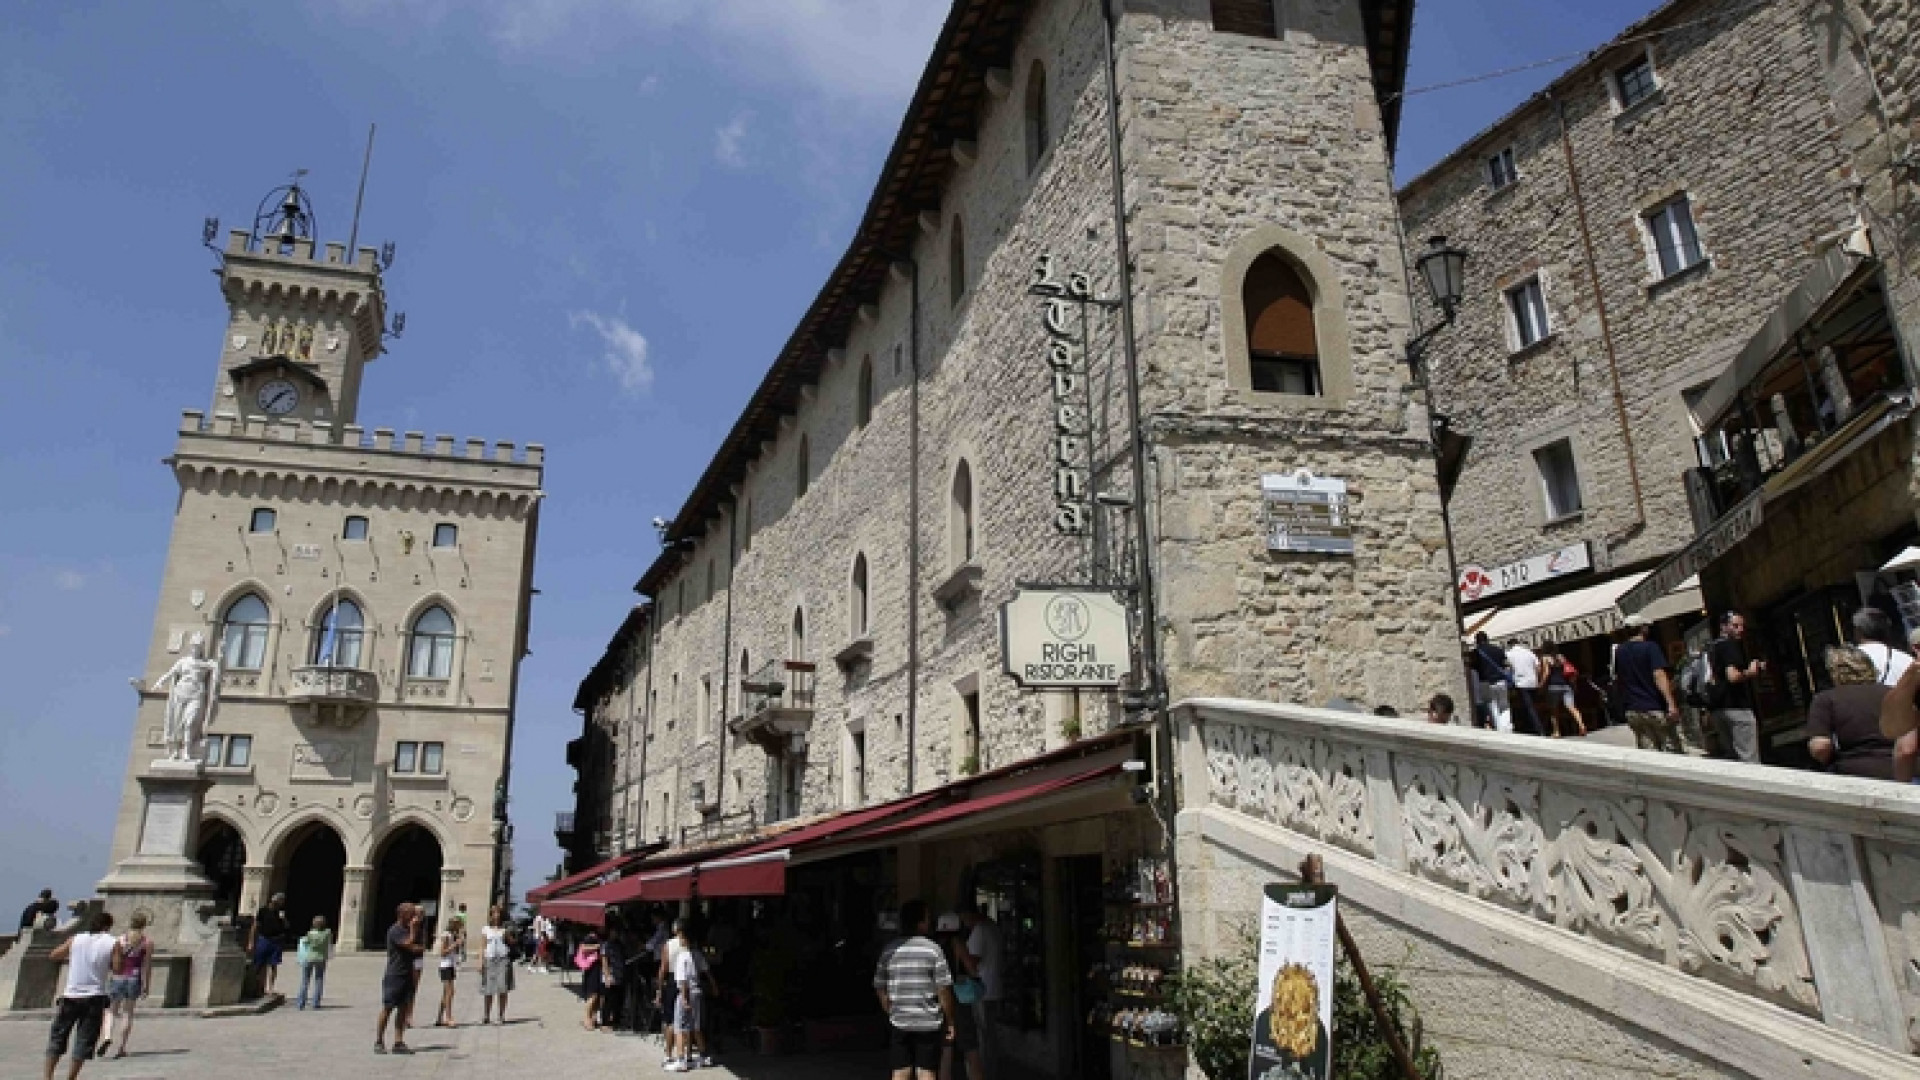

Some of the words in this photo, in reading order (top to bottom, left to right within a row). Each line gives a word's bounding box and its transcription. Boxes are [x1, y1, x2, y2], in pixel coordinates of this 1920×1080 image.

[1029, 253, 1092, 297] La
[1043, 298, 1084, 533] Taverna
[1498, 611, 1622, 649] TORANTE
[1042, 643, 1096, 662] RIGHI
[1024, 663, 1116, 681] RISTORANTE
